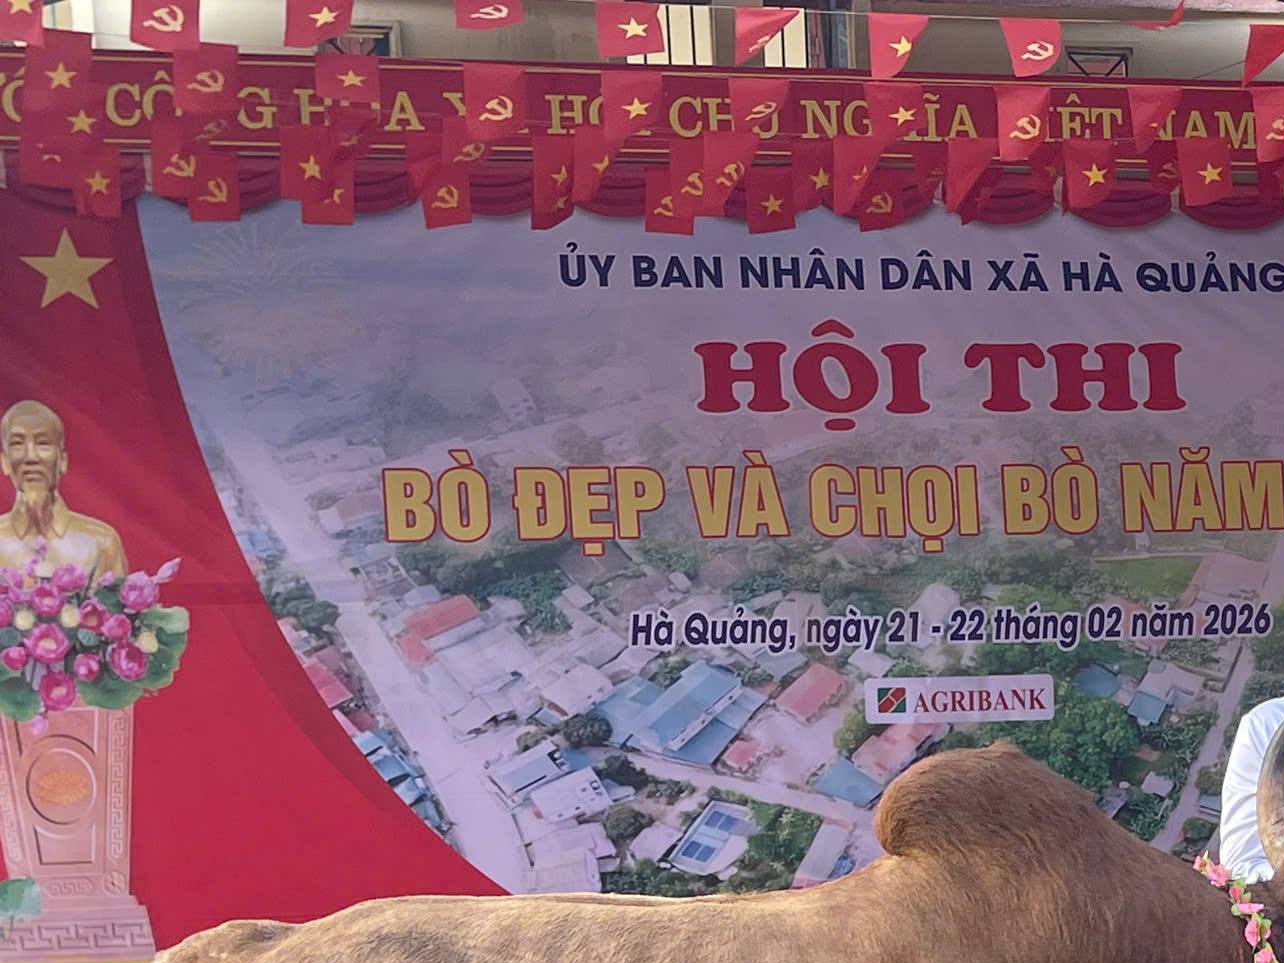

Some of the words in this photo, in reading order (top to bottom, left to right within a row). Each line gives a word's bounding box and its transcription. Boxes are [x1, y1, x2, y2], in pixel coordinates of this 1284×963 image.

[293, 88, 426, 132] HA
[800, 93, 978, 142] NGĨA
[558, 242, 616, 287] ỦY
[632, 255, 724, 289] BAN
[740, 248, 865, 291] NHÂN
[880, 249, 972, 291] DÂN
[987, 252, 1049, 292] XÃ
[1062, 252, 1124, 292] HÀ
[693, 319, 931, 431] HỘI
[963, 342, 1187, 411] THI
[382, 449, 491, 542] BÒ
[513, 466, 665, 556] ĐẸP
[686, 449, 790, 538] VÀ
[808, 464, 980, 553] CHỌI
[1000, 446, 1099, 535] BÒ
[631, 610, 674, 646] Hà
[685, 607, 796, 653] Quảng,
[807, 608, 880, 652] ngày
[888, 611, 919, 642] 21
[931, 625, 941, 633] -
[950, 610, 984, 641] 22
[994, 602, 1079, 648] tháng
[1089, 606, 1122, 637] 02
[1132, 604, 1194, 636] năm
[1204, 603, 1271, 635] 2026
[913, 688, 1047, 713] AGRIBANK
